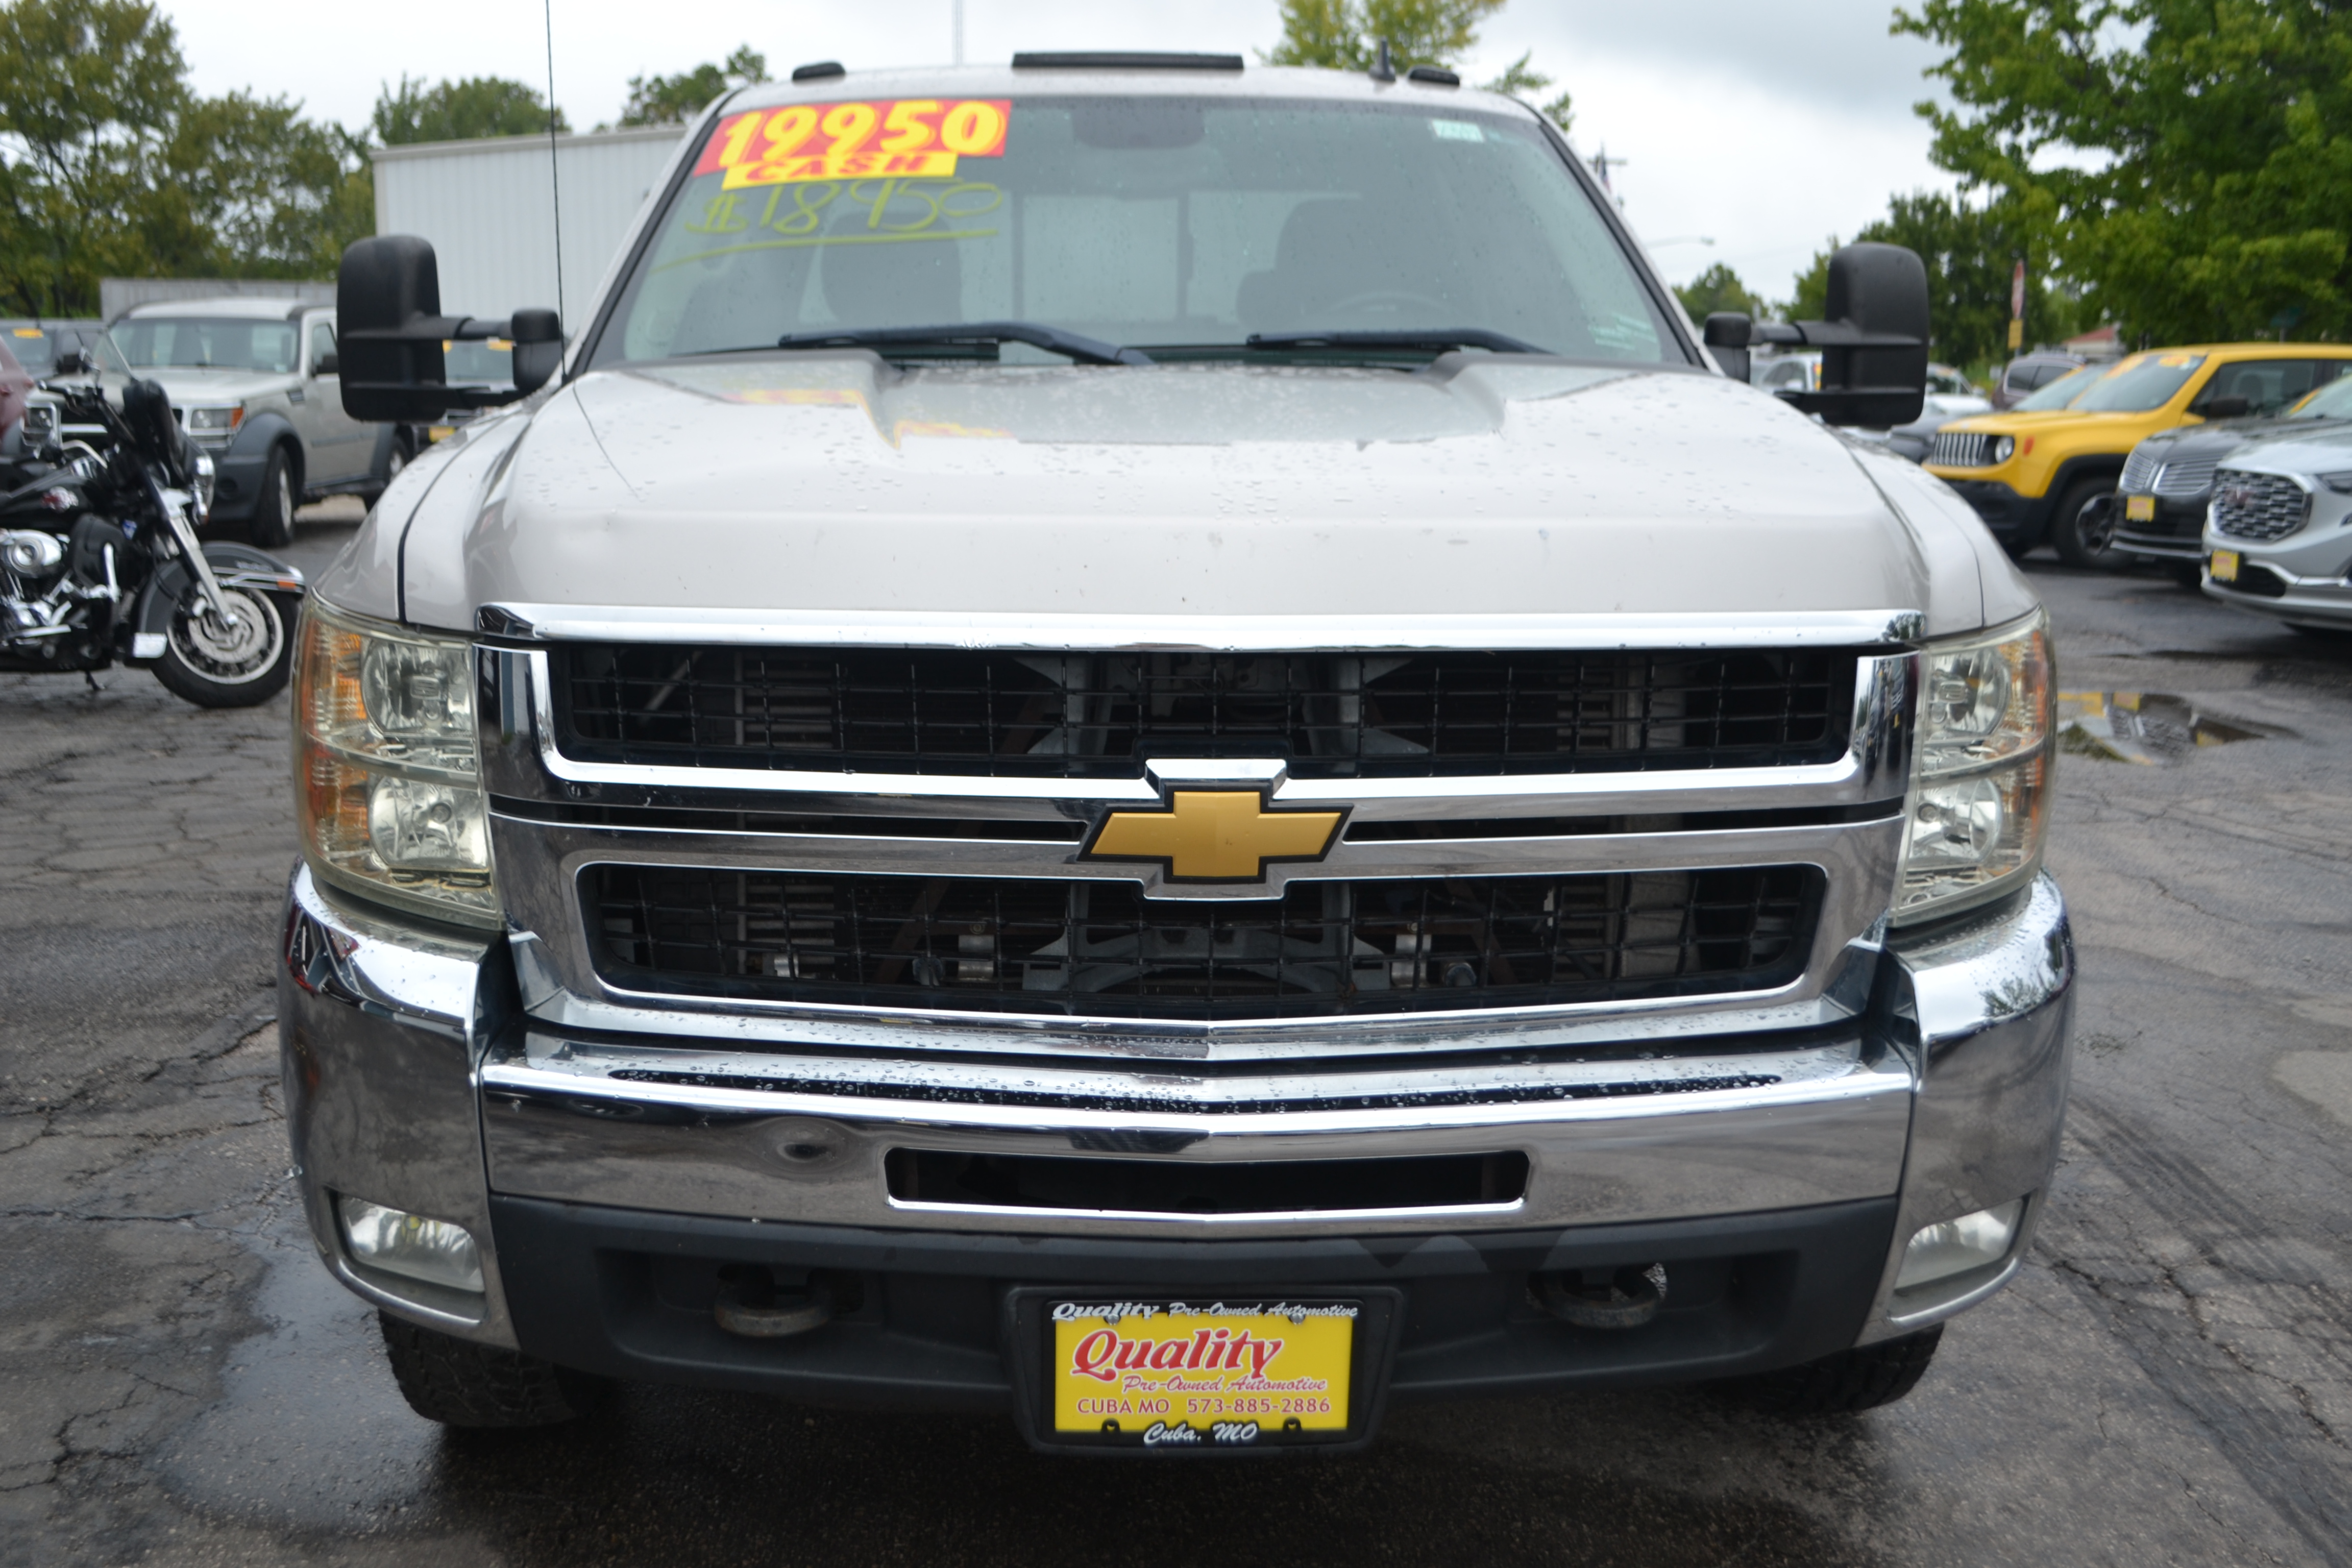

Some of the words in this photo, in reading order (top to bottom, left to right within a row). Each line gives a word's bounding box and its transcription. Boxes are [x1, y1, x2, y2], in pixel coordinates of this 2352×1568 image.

[718, 100, 1004, 168] 19950
[745, 155, 931, 182] CASH
[1052, 1303, 1160, 1321] Quality
[1169, 1302, 1262, 1317] Pre-Owned
[1264, 1302, 1358, 1317] Automotive
[1070, 1328, 1284, 1382] Quality
[1122, 1376, 1223, 1393] Pre-Owned
[1225, 1376, 1327, 1392] Automotive
[1077, 1398, 1132, 1414] CUBA
[1138, 1398, 1170, 1414] MO
[1186, 1397, 1331, 1414] 573-885-2886
[1212, 1423, 1258, 1441] MO
